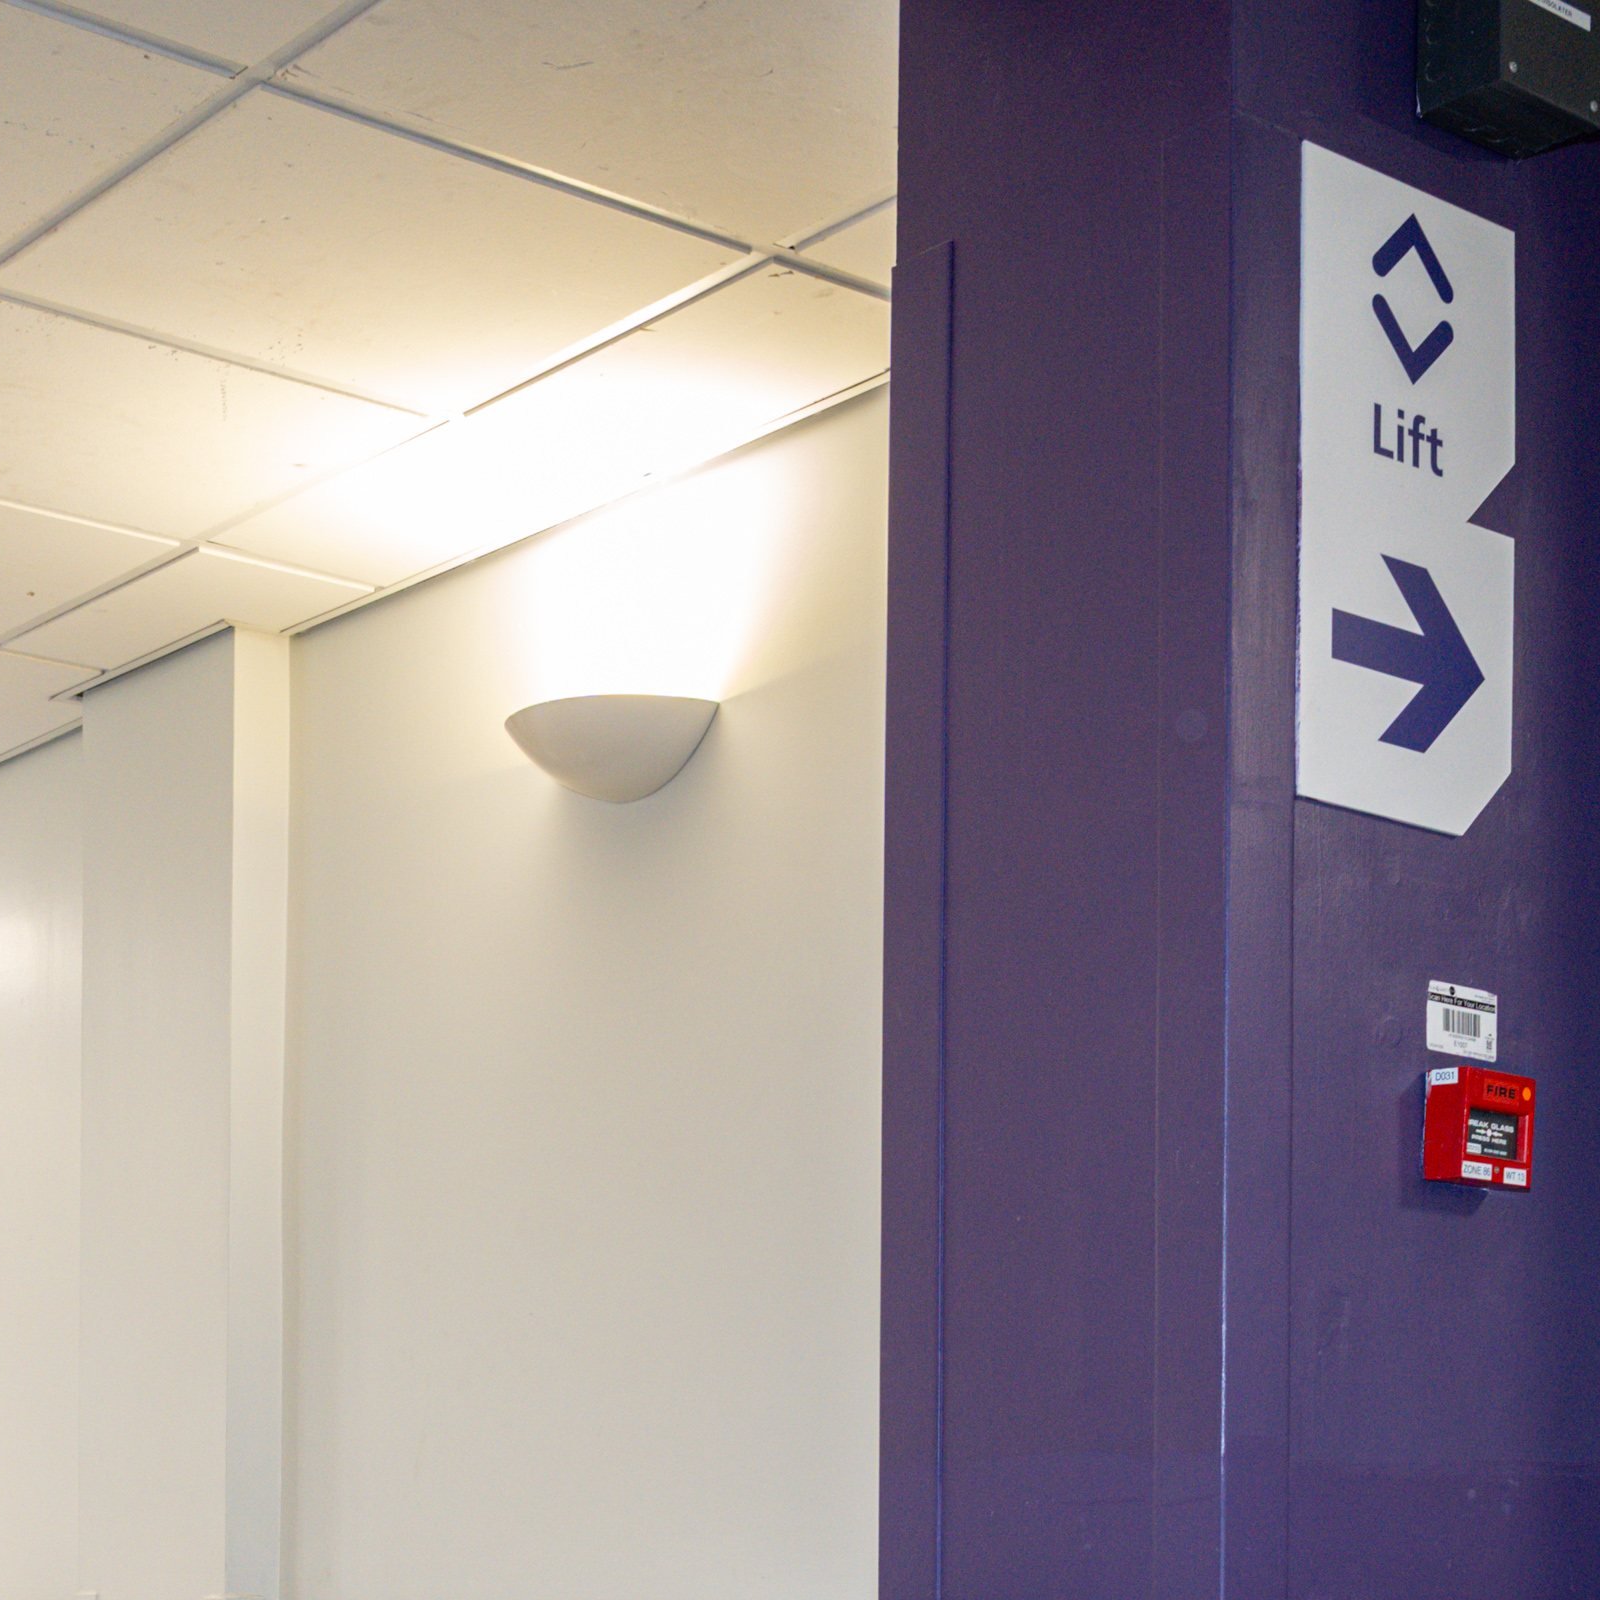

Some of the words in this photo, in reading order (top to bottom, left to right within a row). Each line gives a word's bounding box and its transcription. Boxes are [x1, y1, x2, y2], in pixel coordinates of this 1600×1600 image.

[1373, 402, 1444, 477] Lift
[1441, 995, 1453, 1004] Here
[1454, 997, 1463, 1006] For
[1464, 999, 1475, 1008] Your
[1476, 1001, 1496, 1013] Location
[1435, 1071, 1455, 1081] D031
[1486, 1084, 1516, 1099] FIRE
[1490, 1122, 1514, 1133] GLASS
[1471, 1134, 1490, 1143] PRESS
[1491, 1136, 1507, 1145] HERE
[1463, 1163, 1481, 1175] ZONE
[1506, 1171, 1516, 1180] WT
[1517, 1173, 1526, 1182] 13
